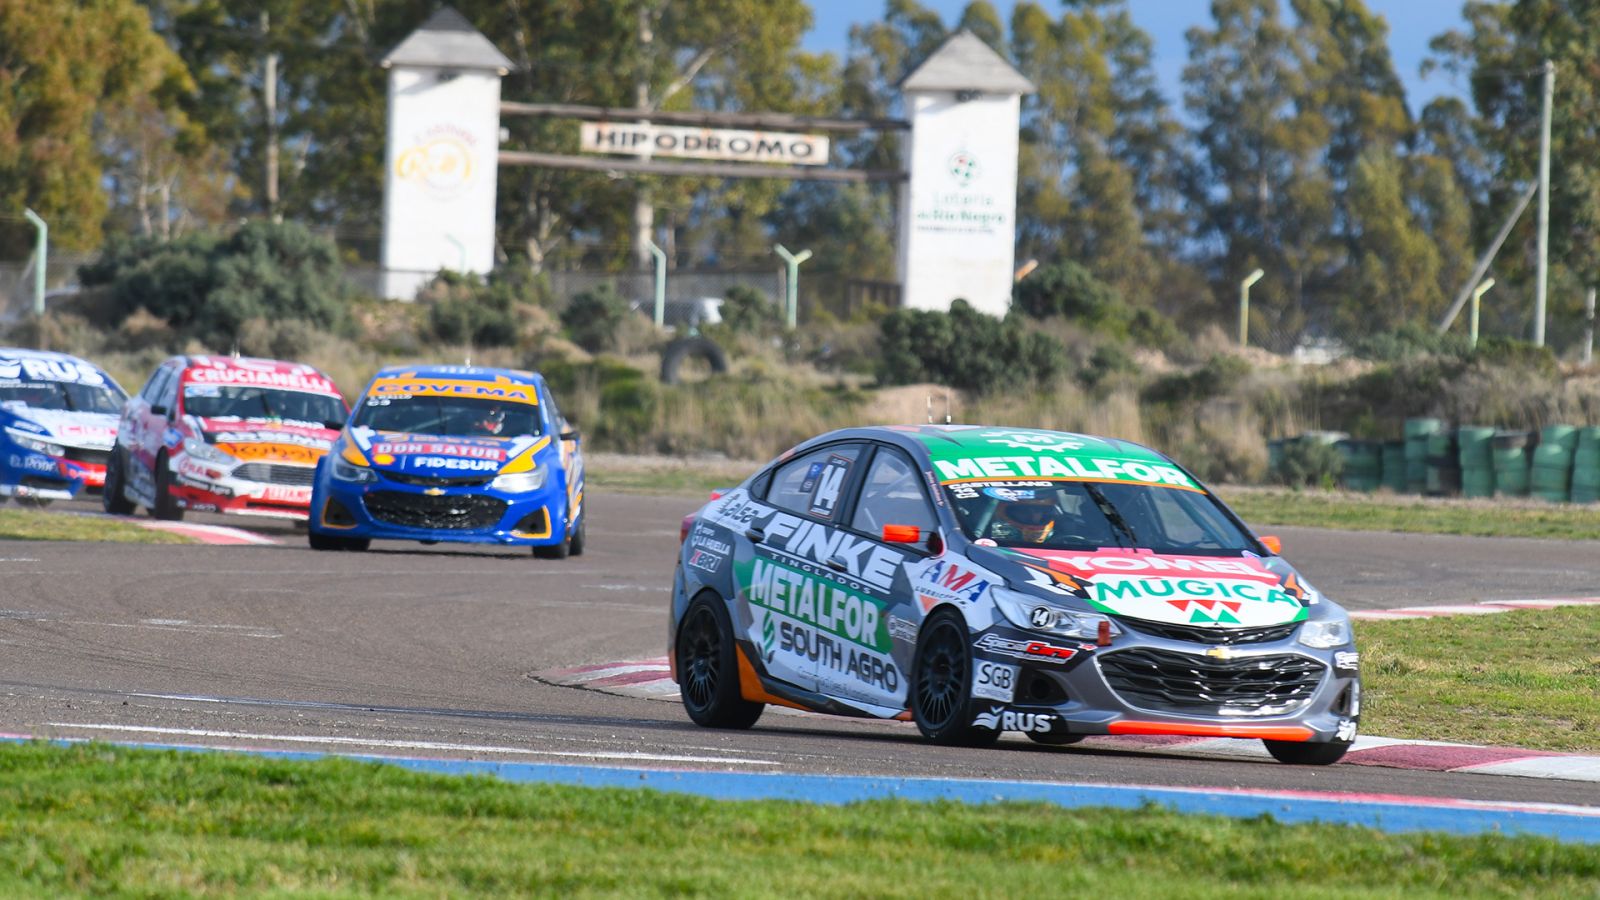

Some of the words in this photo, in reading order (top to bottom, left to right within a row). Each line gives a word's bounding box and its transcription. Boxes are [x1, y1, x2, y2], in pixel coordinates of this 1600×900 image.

[595, 128, 814, 158] HIPODROMO
[21, 358, 104, 386] RUS
[191, 368, 332, 392] CRUCIANELLI
[376, 383, 529, 400] COVEMA
[377, 443, 424, 454] DON
[430, 444, 500, 460] SATUR
[413, 456, 499, 472] FIDESUR
[933, 456, 1191, 487] METALFOR
[813, 464, 847, 510] 14
[948, 481, 1053, 490] CASTELLANO
[763, 512, 904, 590] FINKE
[771, 553, 871, 595] TINGLADOS
[1055, 555, 1272, 579] YOMEL
[919, 560, 990, 603] AMA
[750, 559, 879, 648] METALFOR
[1031, 609, 1049, 626] 14
[780, 620, 842, 671] SOUTH
[845, 651, 898, 694] AGRO
[979, 664, 1012, 689] SGB
[1002, 711, 1053, 734] RUS
